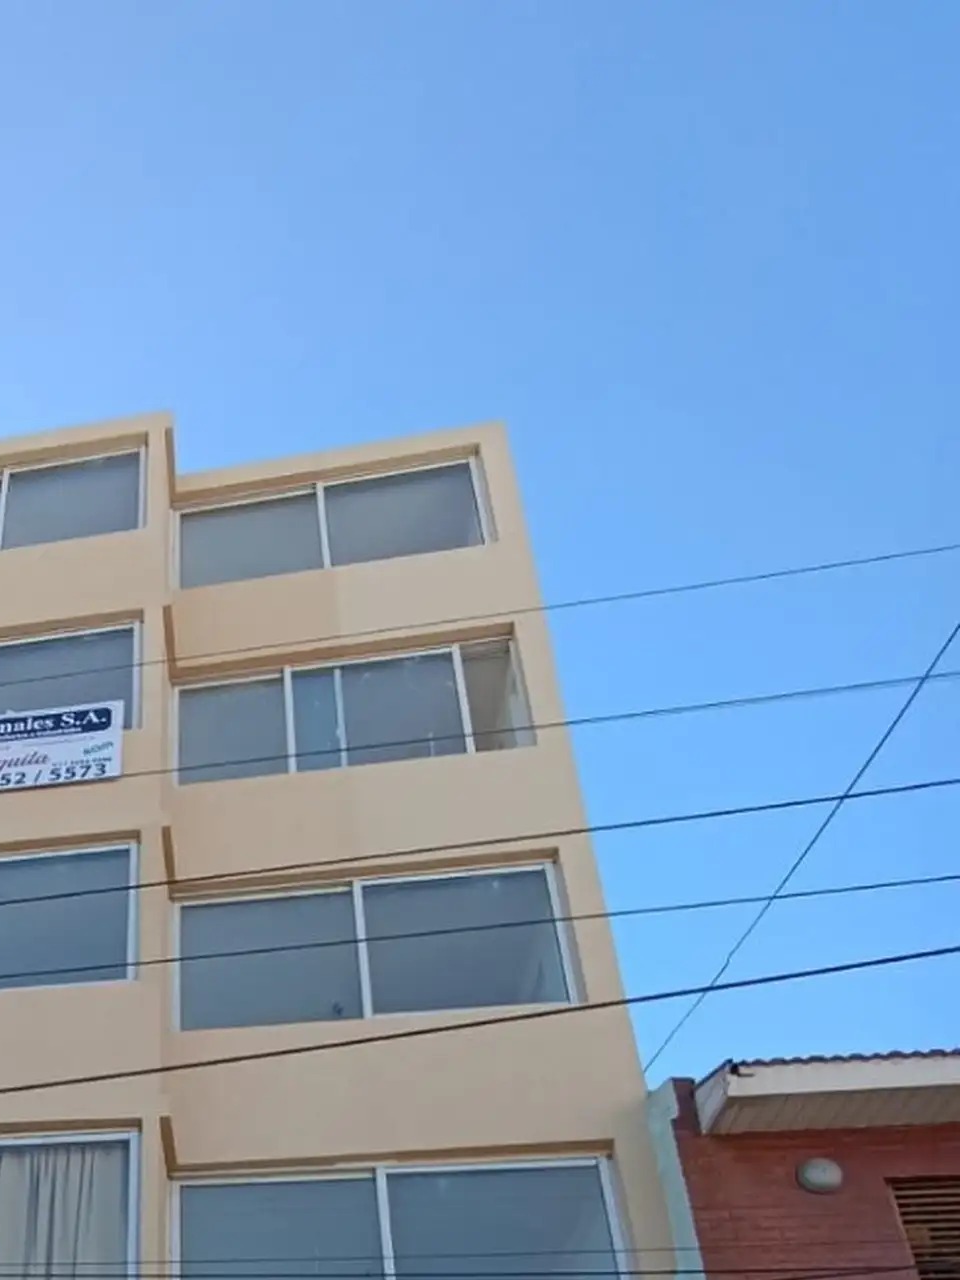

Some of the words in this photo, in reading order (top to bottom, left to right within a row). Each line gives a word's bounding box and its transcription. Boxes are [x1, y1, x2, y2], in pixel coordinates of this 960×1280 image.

[60, 711, 107, 730] S.A.
[33, 770, 43, 783] /
[49, 763, 107, 782] 5573
